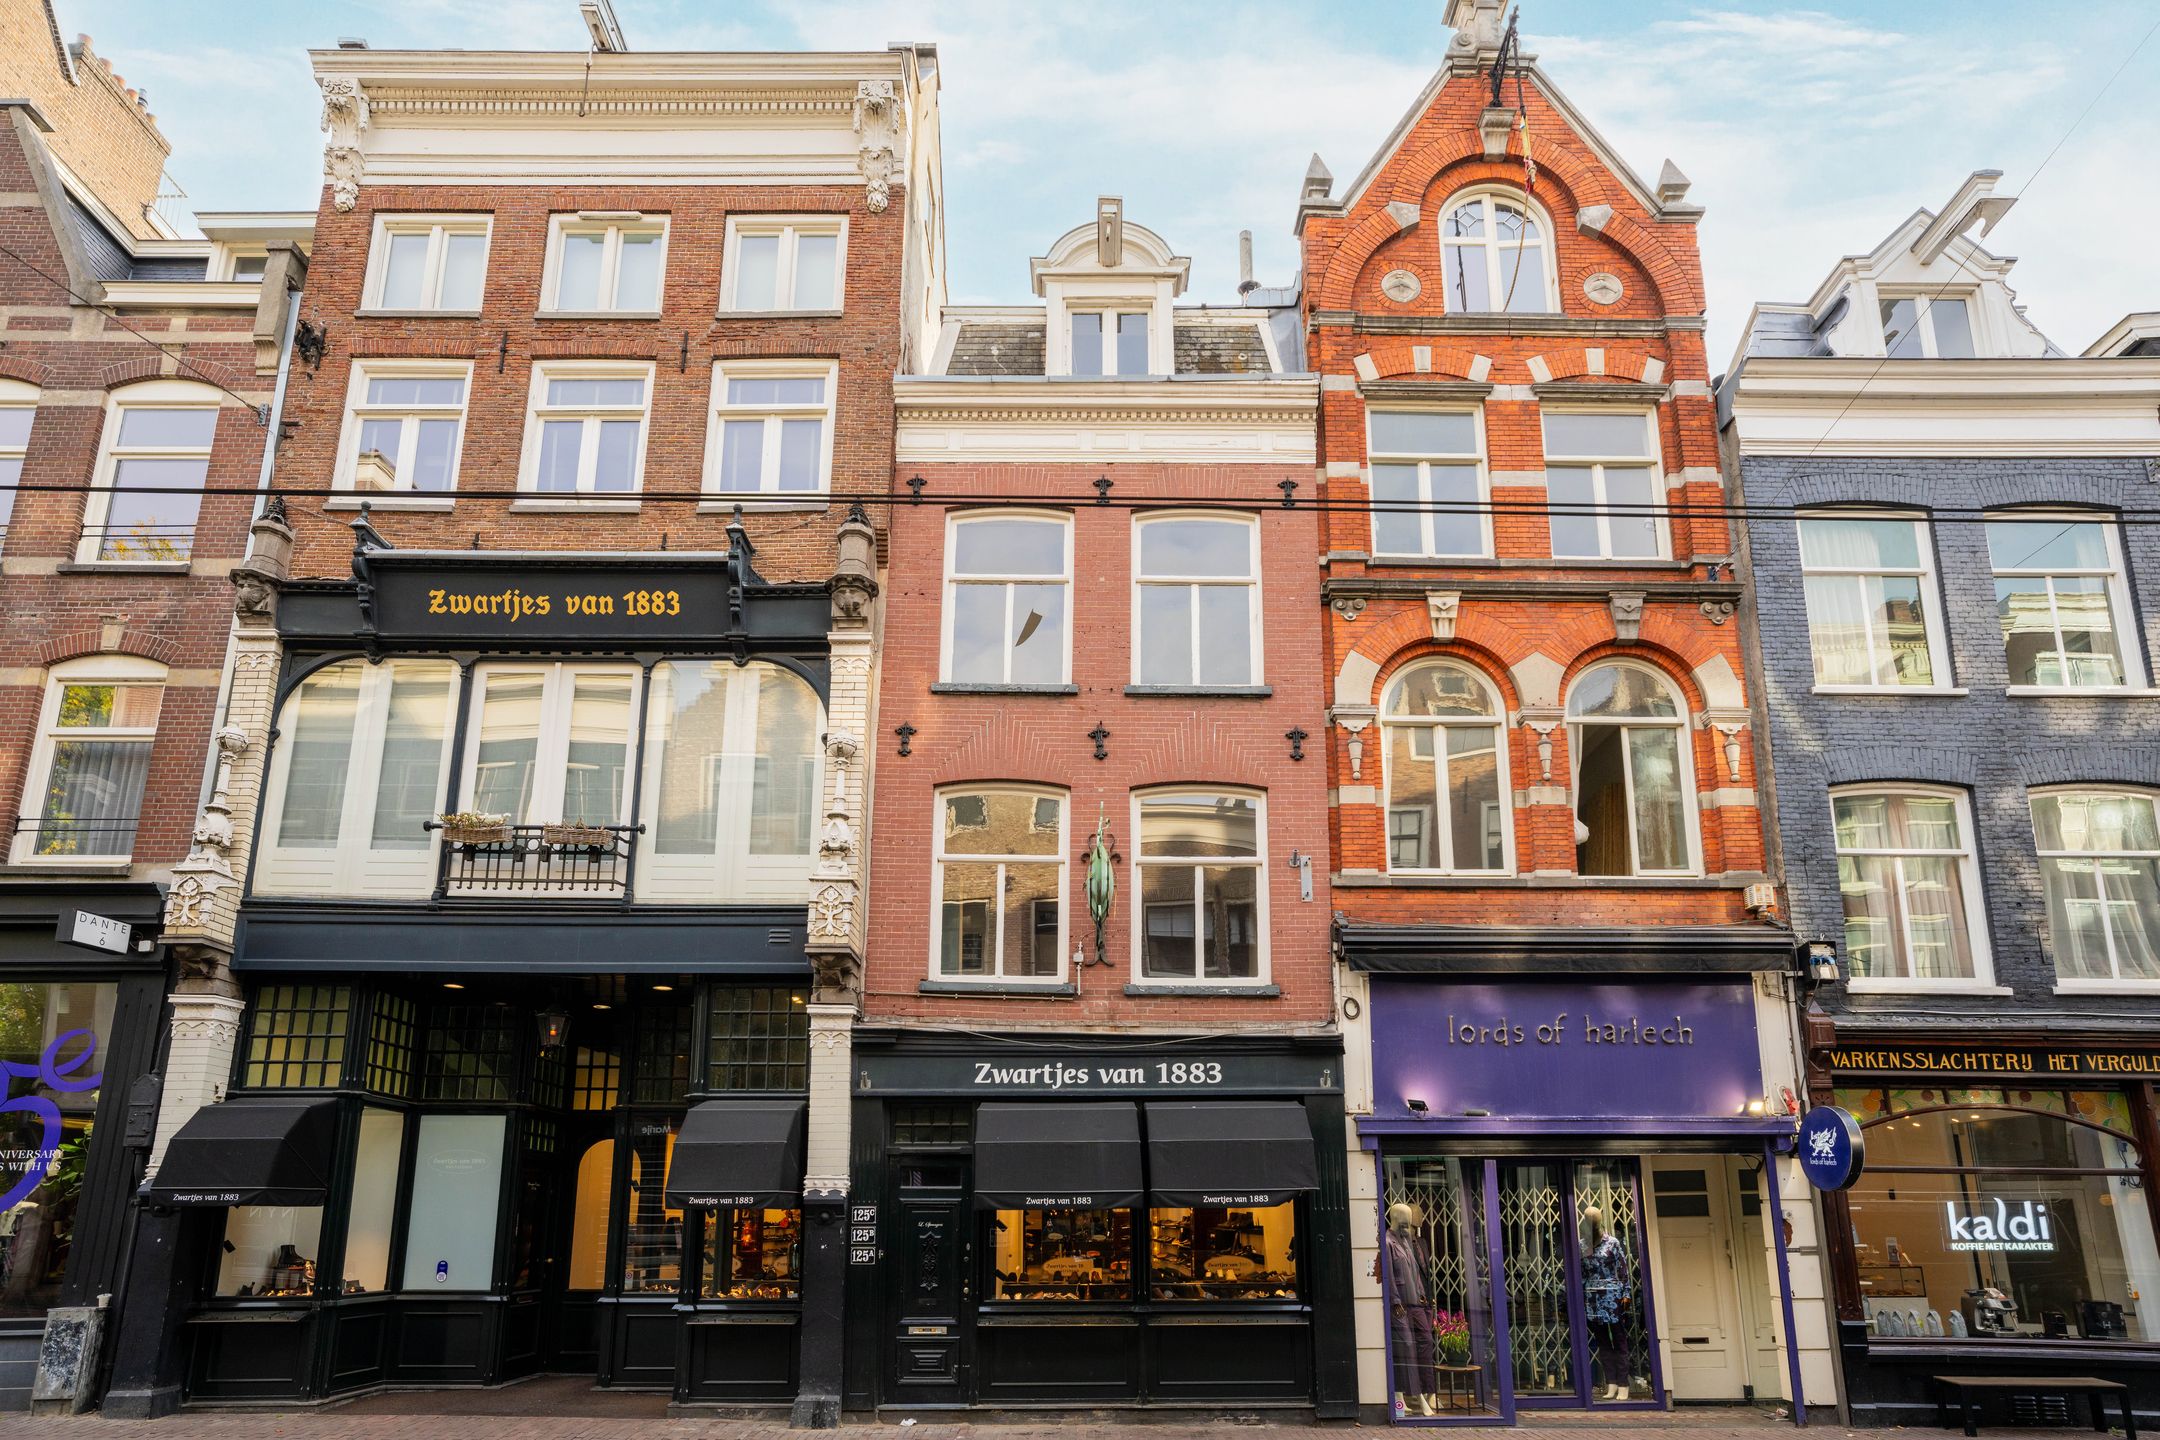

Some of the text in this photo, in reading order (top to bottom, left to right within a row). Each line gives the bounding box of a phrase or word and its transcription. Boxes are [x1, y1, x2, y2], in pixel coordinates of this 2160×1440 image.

[428, 589, 680, 622] Zwartjes van 1883
[80, 913, 127, 934] DANTE
[99, 937, 105, 945] 6
[1447, 1012, 1694, 1047] lords of harlech
[1830, 1051, 2033, 1070] VARKENSSLACHTERIJ
[2048, 1054, 2080, 1070] HET
[974, 1062, 1222, 1090] Zwartjes van 1883
[9, 1162, 41, 1170] WITH
[46, 1162, 61, 1170] US
[172, 1193, 203, 1202] Zwartjes
[688, 1196, 718, 1205] Zwartjes
[735, 1196, 754, 1204] 1883
[1026, 1197, 1055, 1206] Zwartjes
[1072, 1196, 1092, 1204] 1883
[1203, 1195, 1232, 1204] Zwartjes
[1249, 1195, 1269, 1203] 1883
[853, 1209, 875, 1221] 125C
[1946, 1197, 2049, 1240] kaldi
[852, 1229, 875, 1242] 125B
[1952, 1242, 2054, 1251] KOFFIE MET KARAKTER
[852, 1250, 874, 1262] 125A
